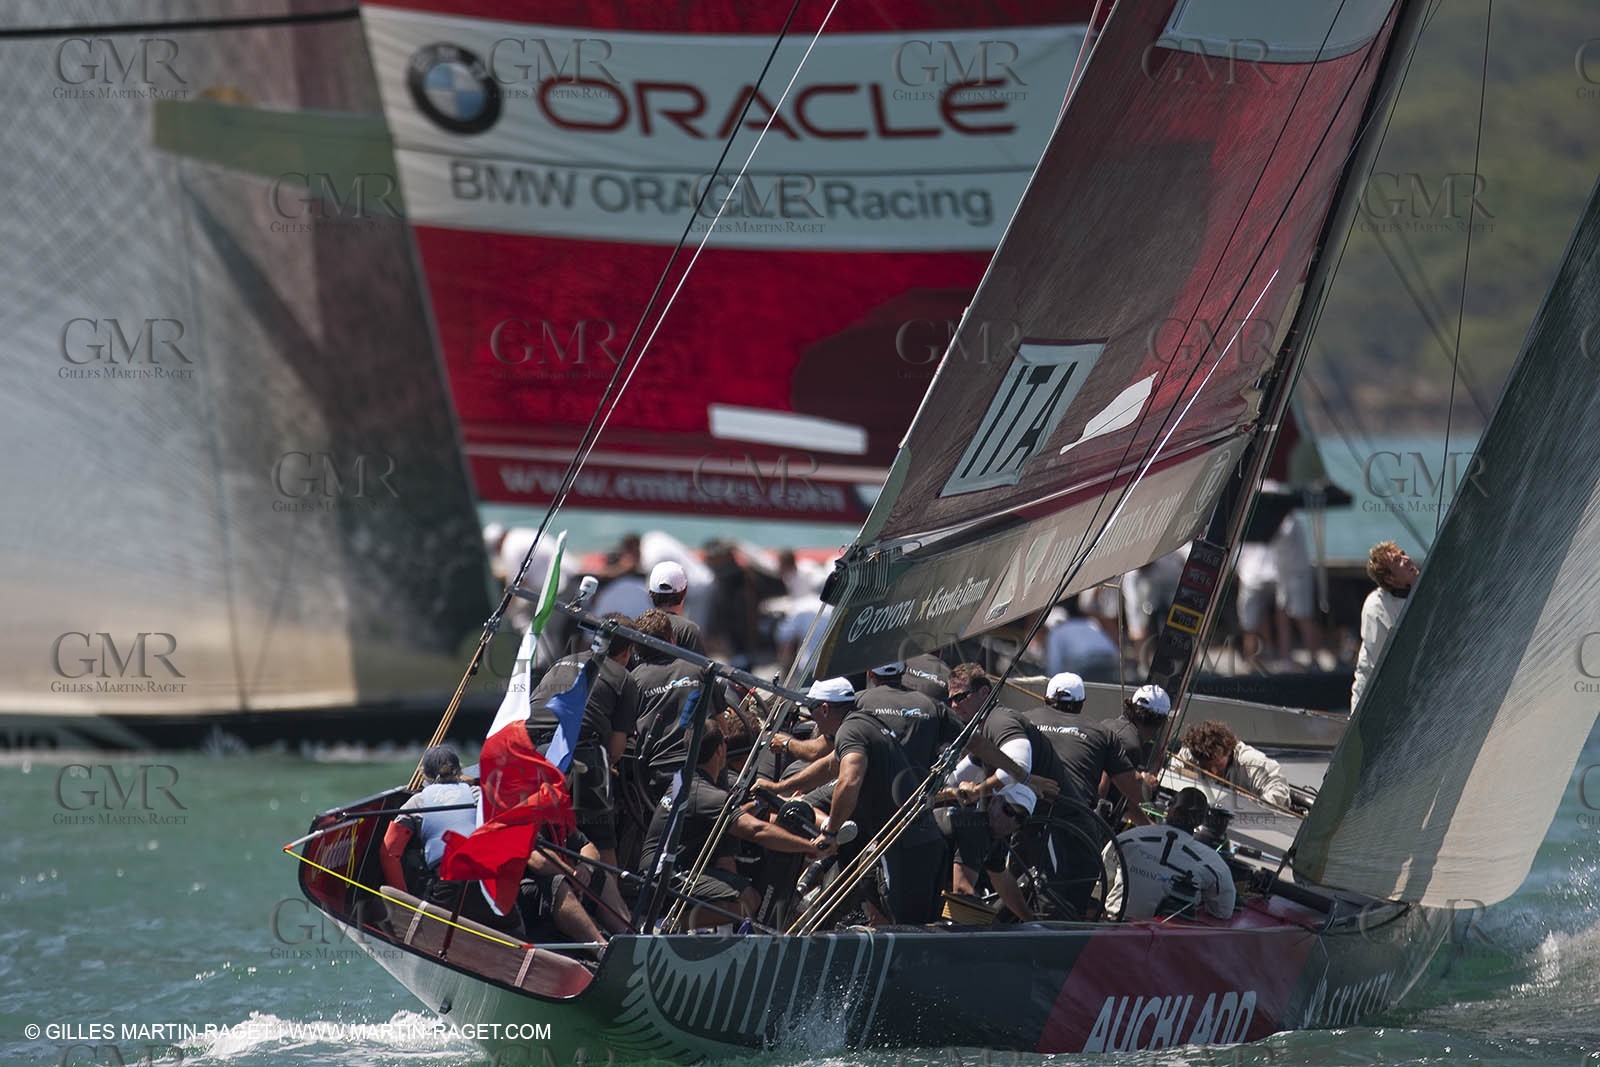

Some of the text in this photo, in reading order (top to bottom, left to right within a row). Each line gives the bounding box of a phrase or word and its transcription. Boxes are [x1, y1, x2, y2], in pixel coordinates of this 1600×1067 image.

[537, 75, 1016, 140] ORACLE
[451, 160, 994, 227] BMW ORACLE Racing
[960, 361, 1078, 479] ITA
[866, 599, 916, 635] TOYOTA
